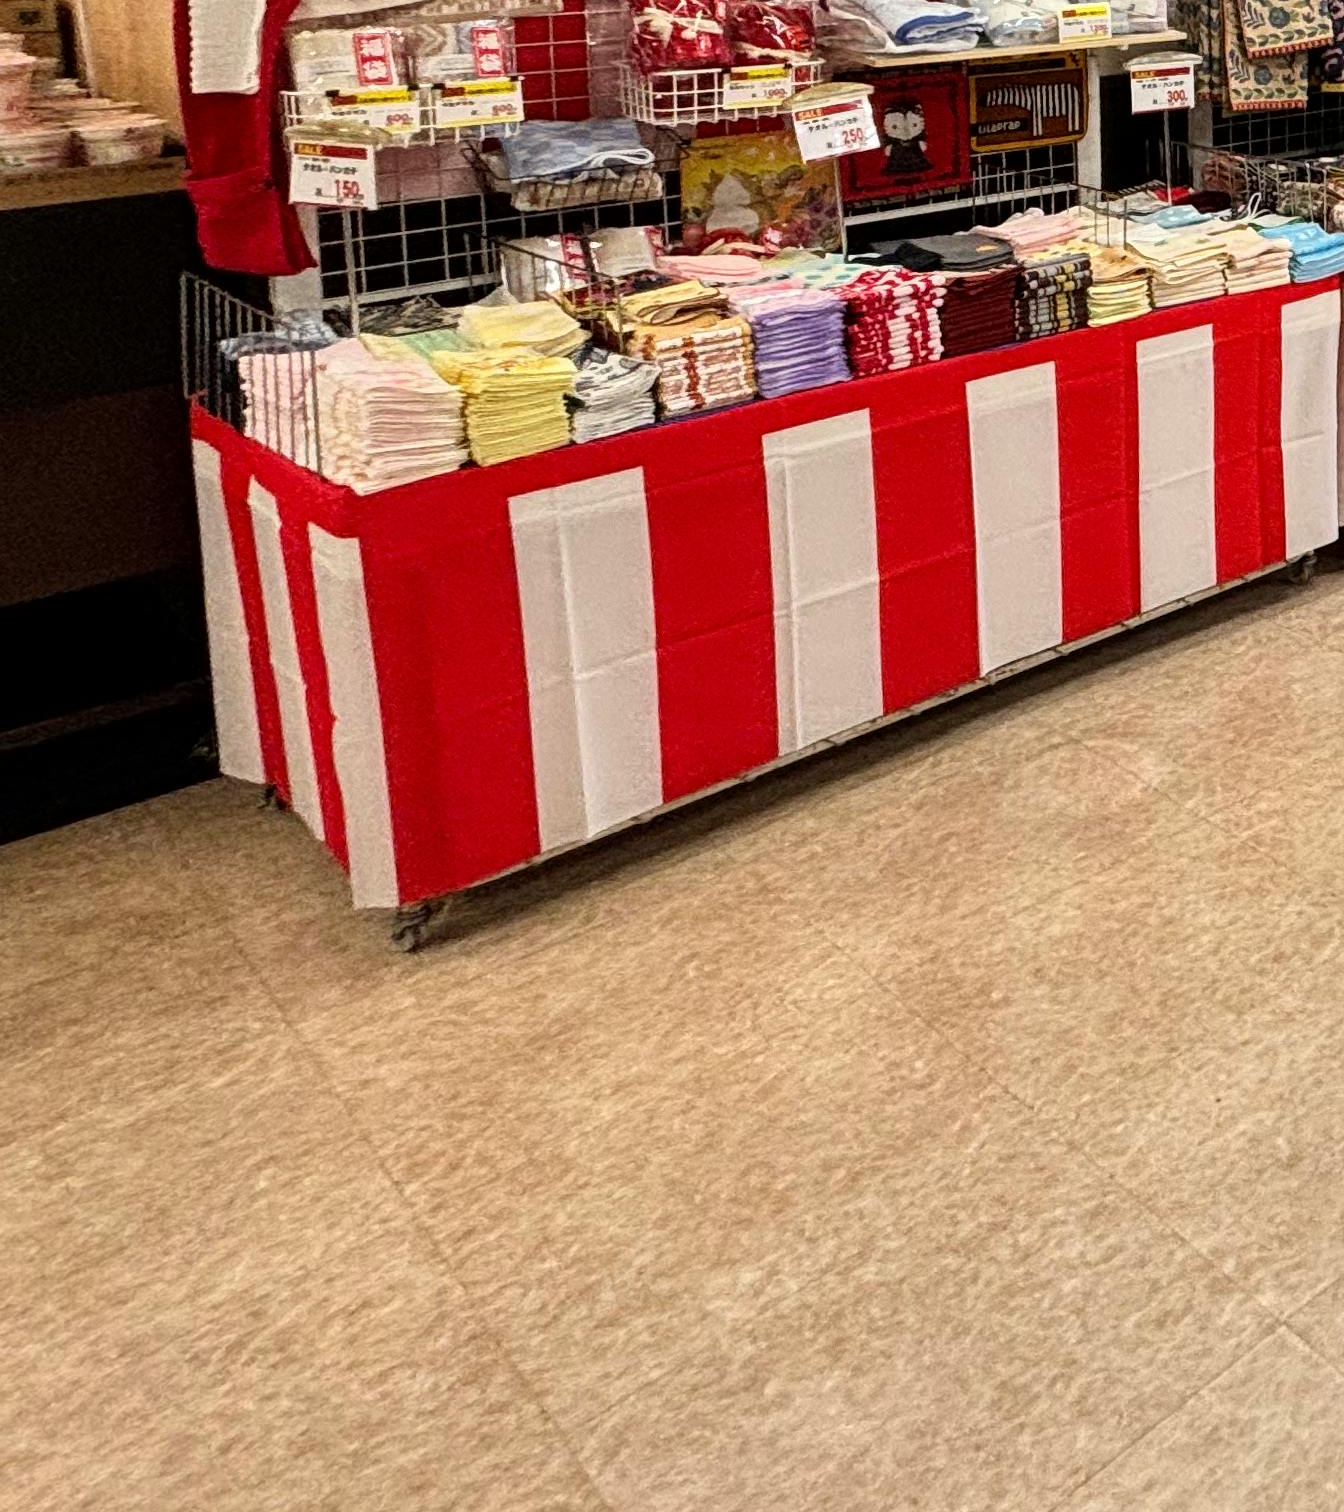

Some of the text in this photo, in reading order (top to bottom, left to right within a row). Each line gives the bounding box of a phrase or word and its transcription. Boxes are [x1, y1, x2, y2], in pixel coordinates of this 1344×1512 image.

[1166, 89, 1186, 103] 300
[842, 128, 864, 145] 250
[335, 179, 360, 200] 150
